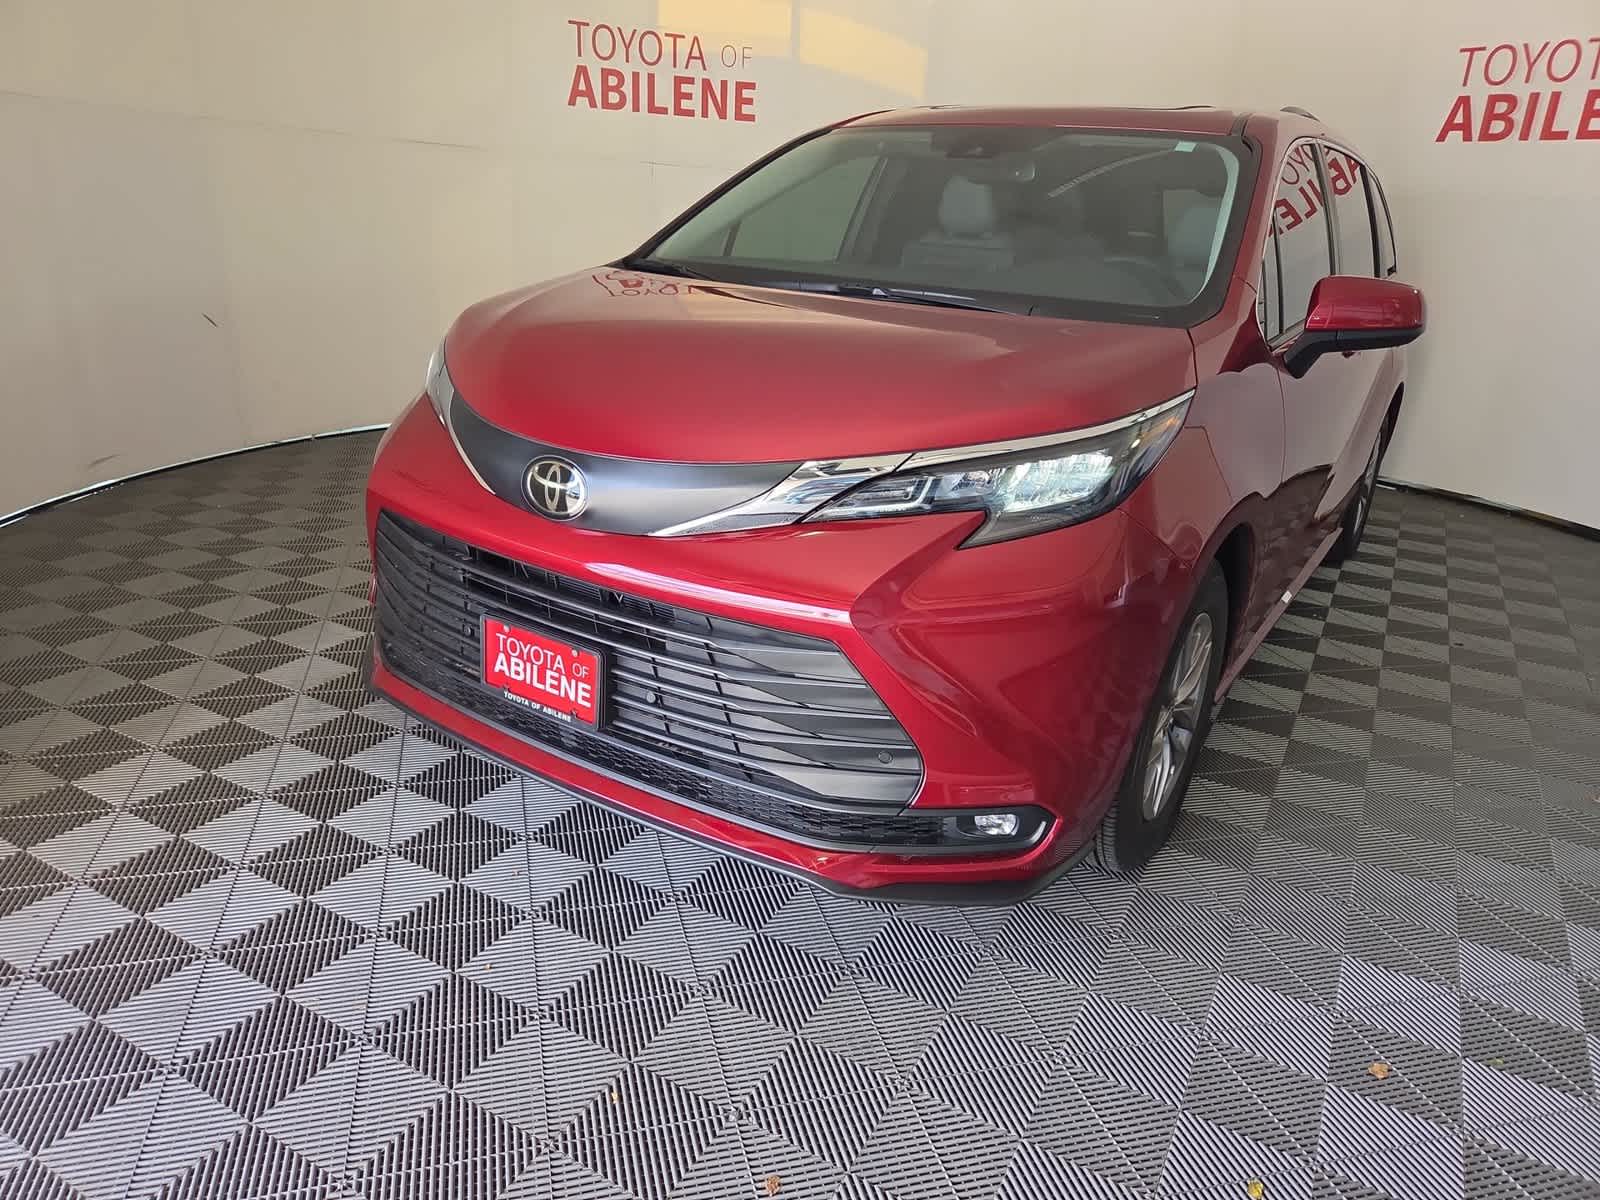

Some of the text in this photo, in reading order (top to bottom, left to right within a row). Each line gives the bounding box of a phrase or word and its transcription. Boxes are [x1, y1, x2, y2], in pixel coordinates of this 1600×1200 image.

[567, 20, 753, 71] TOYOTA OF
[567, 64, 757, 122] ABILENE
[493, 652, 592, 709] ABILENE
[495, 632, 590, 679] TOYOTA OF
[503, 690, 572, 723] TOYOTA OF ABILENE
